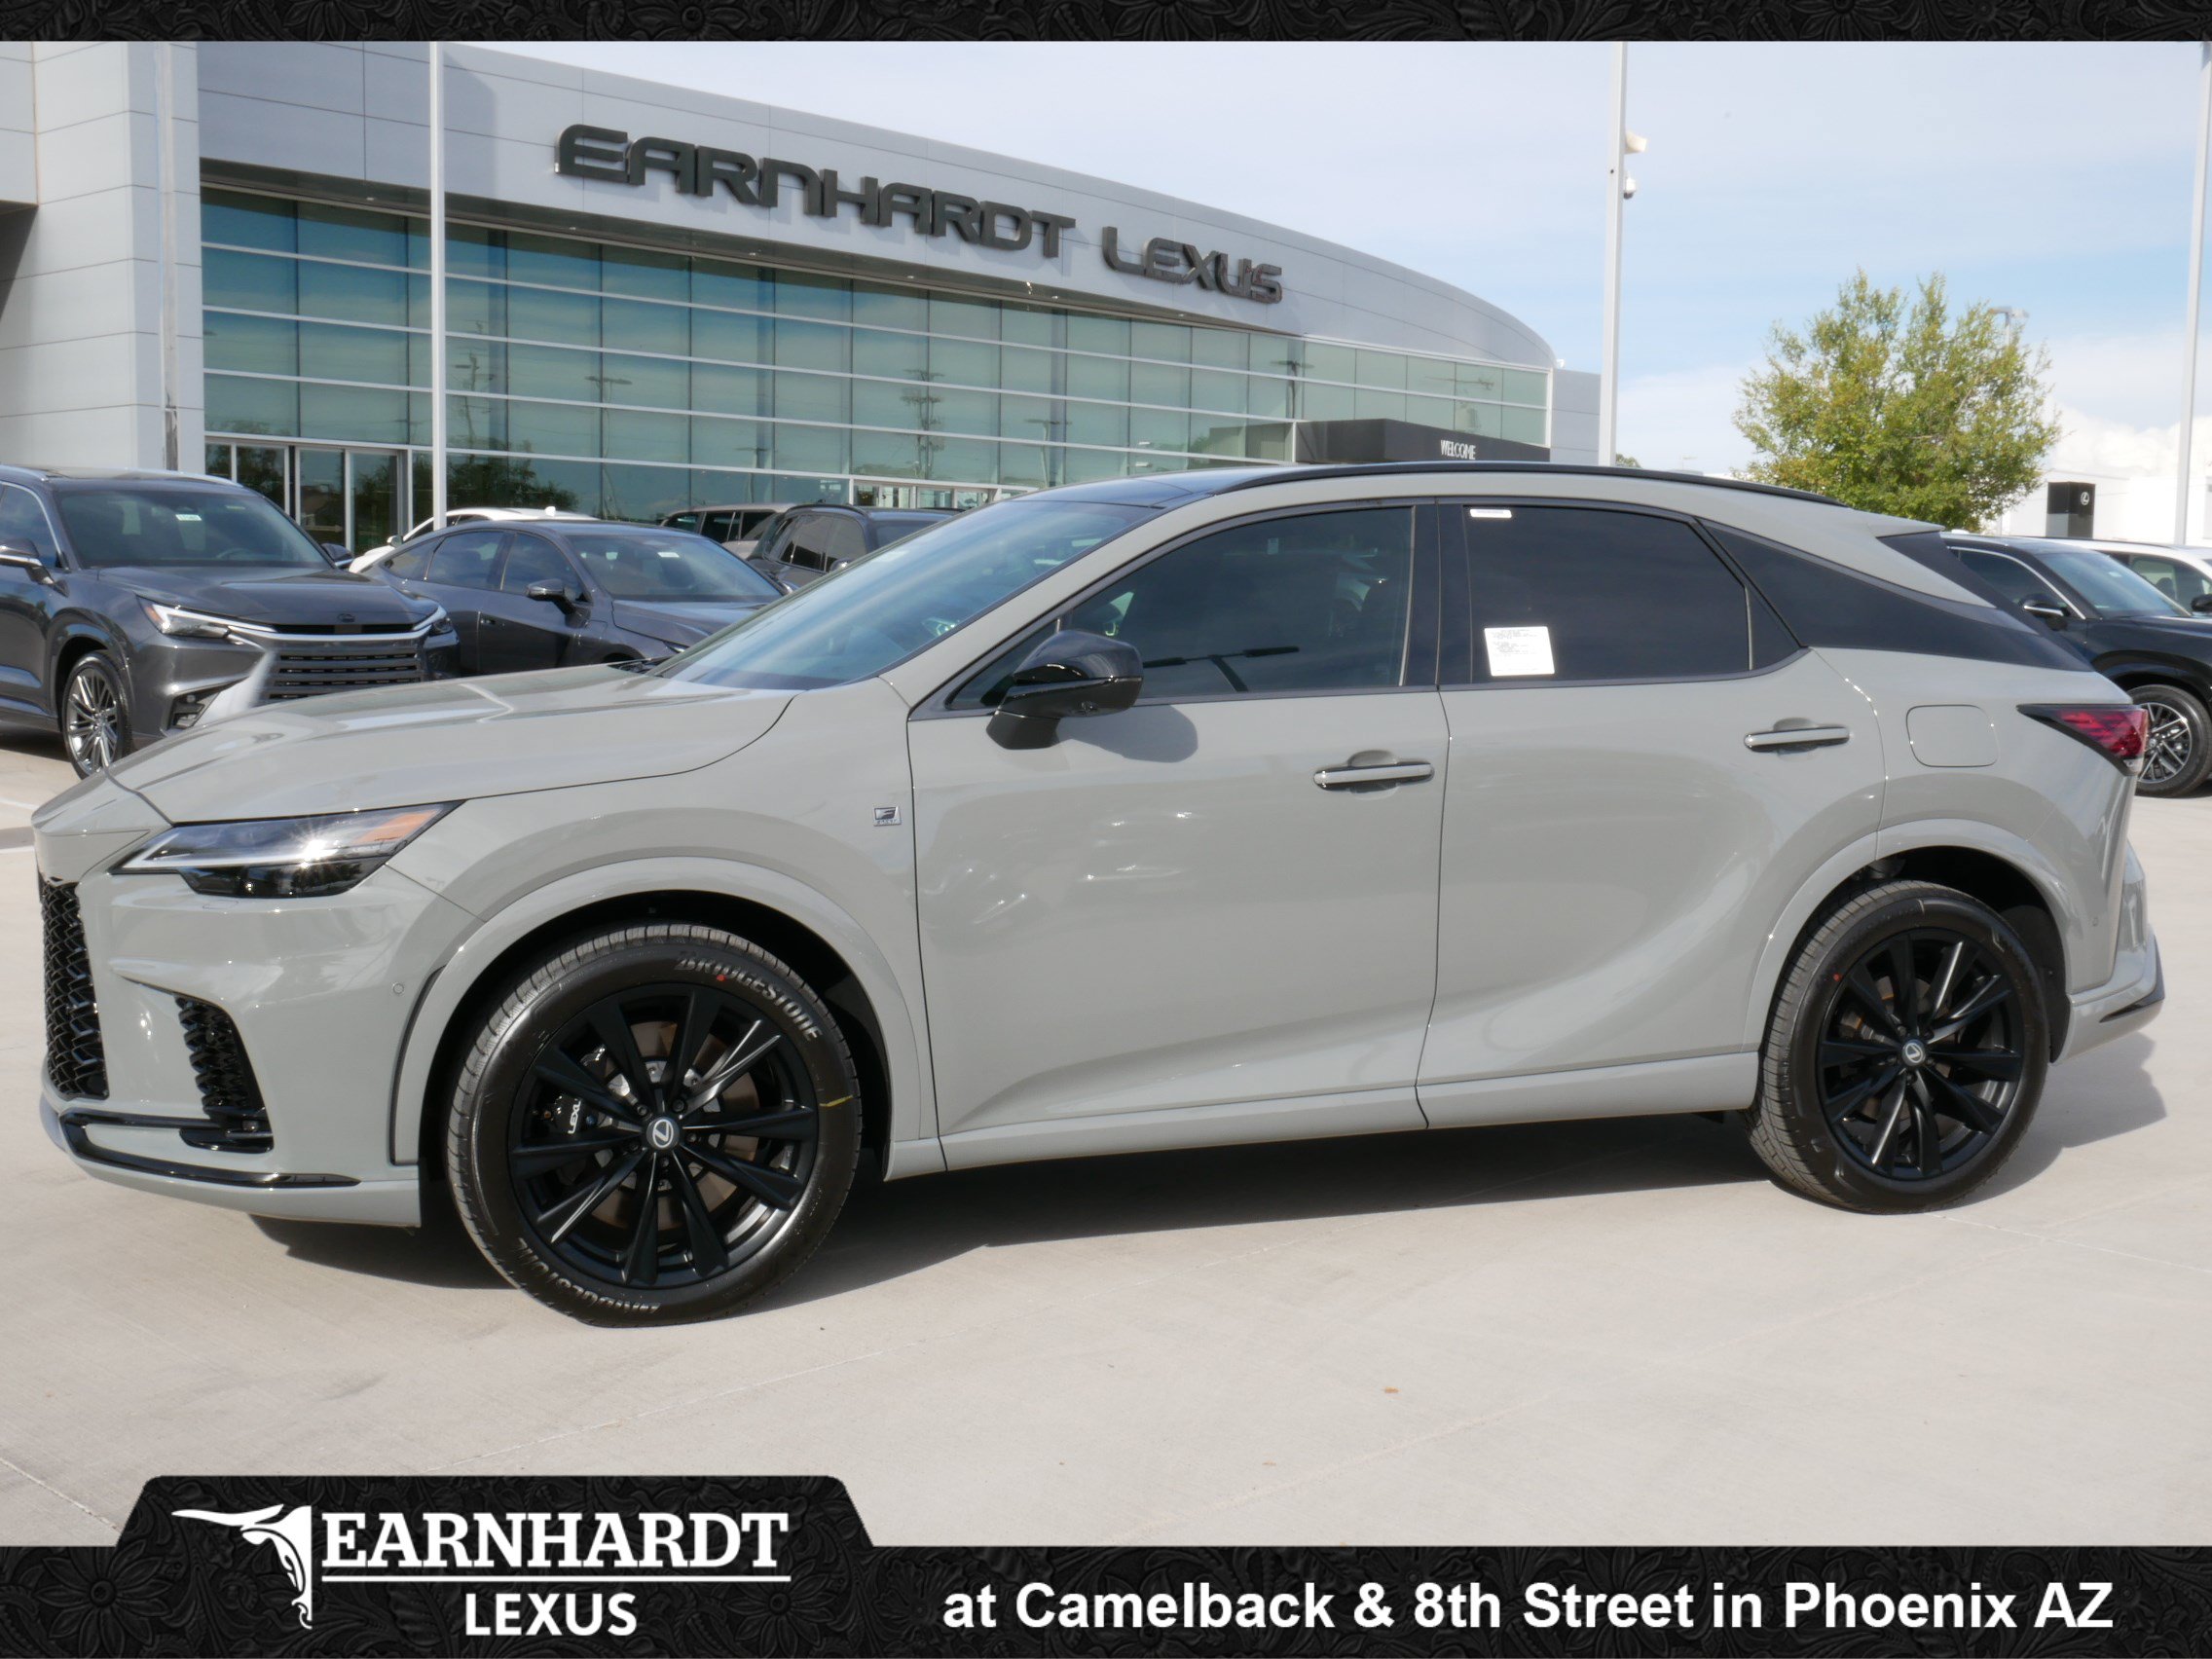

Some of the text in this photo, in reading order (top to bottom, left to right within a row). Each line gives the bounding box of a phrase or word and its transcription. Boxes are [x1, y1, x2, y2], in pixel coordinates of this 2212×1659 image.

[554, 123, 1284, 304] EARNHARDT LEXUS
[1440, 439, 1477, 461] WELCOME
[674, 952, 824, 1042] BRIDGESTONE
